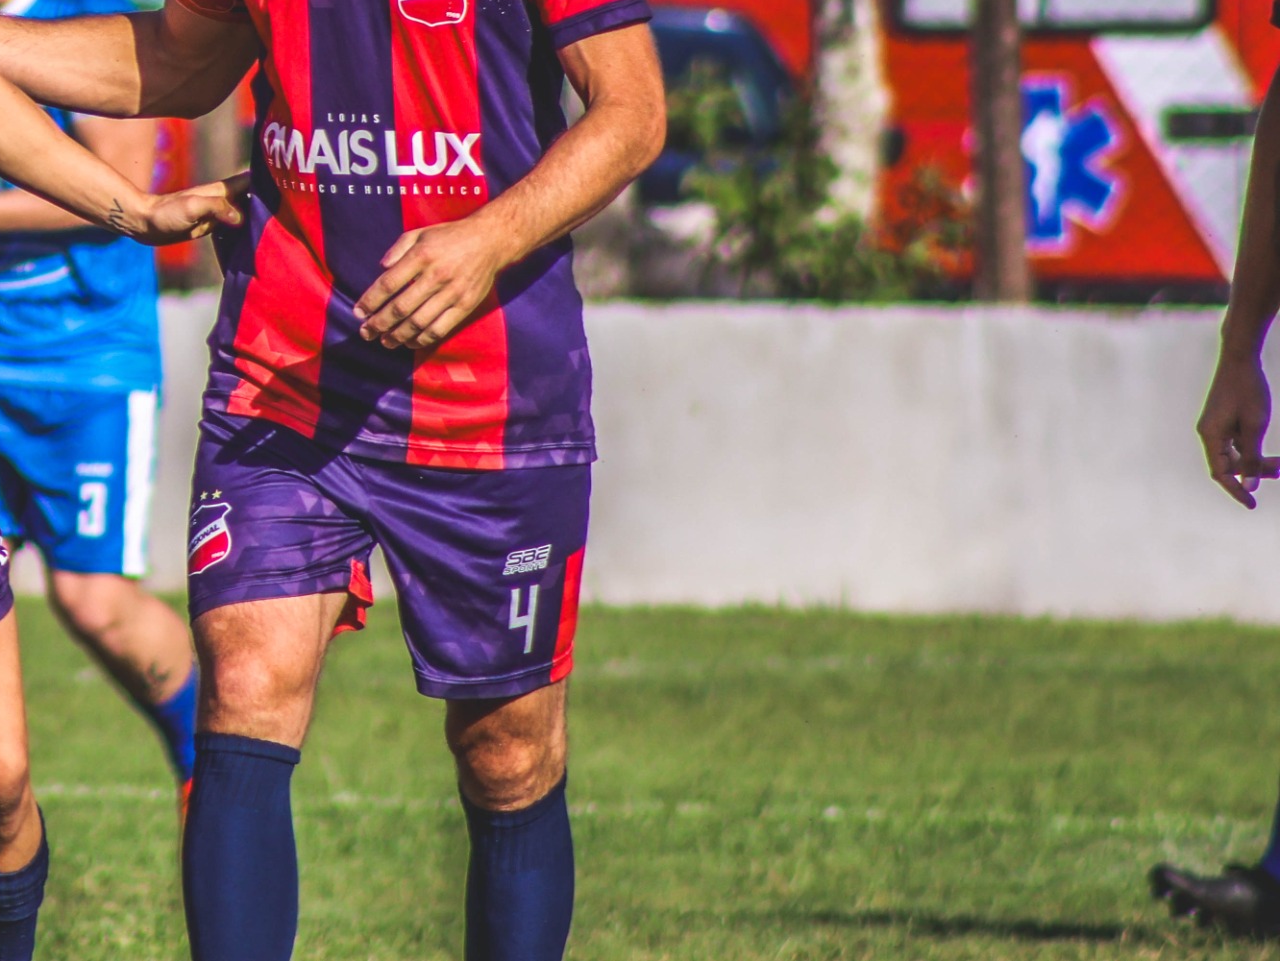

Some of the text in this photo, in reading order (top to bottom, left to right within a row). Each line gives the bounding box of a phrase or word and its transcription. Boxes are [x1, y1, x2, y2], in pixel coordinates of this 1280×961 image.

[328, 113, 380, 123] LOJAS
[268, 124, 484, 176] MAIS LUX
[348, 185, 355, 195] E
[364, 183, 481, 195] HIDRÁULICO
[78, 482, 107, 536] 3
[505, 544, 552, 567] SBE
[502, 560, 548, 575] SPORTS
[508, 584, 539, 654] 4
